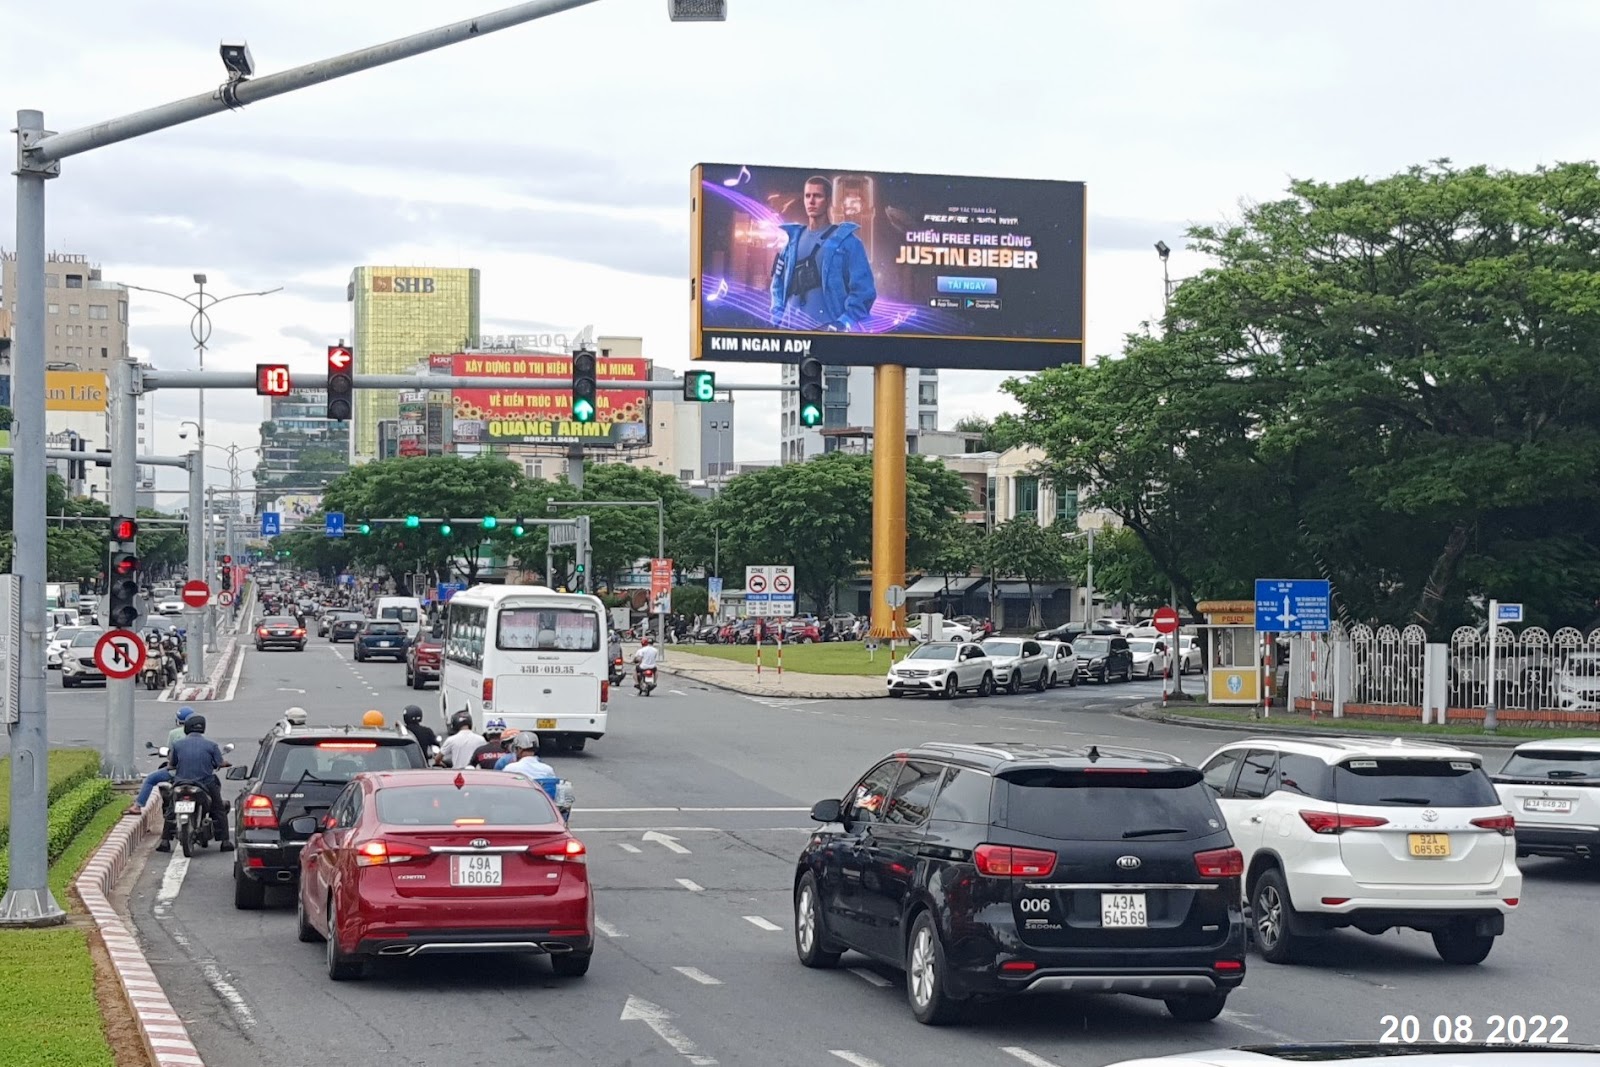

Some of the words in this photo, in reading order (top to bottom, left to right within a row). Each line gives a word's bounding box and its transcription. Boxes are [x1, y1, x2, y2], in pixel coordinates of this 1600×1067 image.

[906, 229, 939, 243] CHIẾN
[942, 232, 970, 244] FREE
[973, 234, 998, 246] FIRE
[1001, 233, 1031, 247] CÙNG
[48, 250, 88, 265] HOTEL
[896, 245, 965, 267] JUSTIN
[968, 248, 1038, 269] BIEBER
[394, 277, 434, 293] SHB
[963, 281, 986, 290] NGAY
[711, 337, 738, 350] KIM
[742, 338, 780, 352] NGAN
[784, 340, 811, 352] ADV
[267, 368, 289, 393] 10
[698, 375, 713, 400] 6
[46, 389, 65, 400] un
[71, 386, 101, 400] Life
[489, 422, 552, 437] QUANG
[558, 421, 612, 437] ARMY
[1420, 835, 1438, 845] 92A
[469, 857, 491, 871] 49A
[1120, 857, 1139, 867] KIA
[461, 871, 500, 884] 160.62
[1020, 899, 1050, 912] 006
[1113, 896, 1135, 909] 43A
